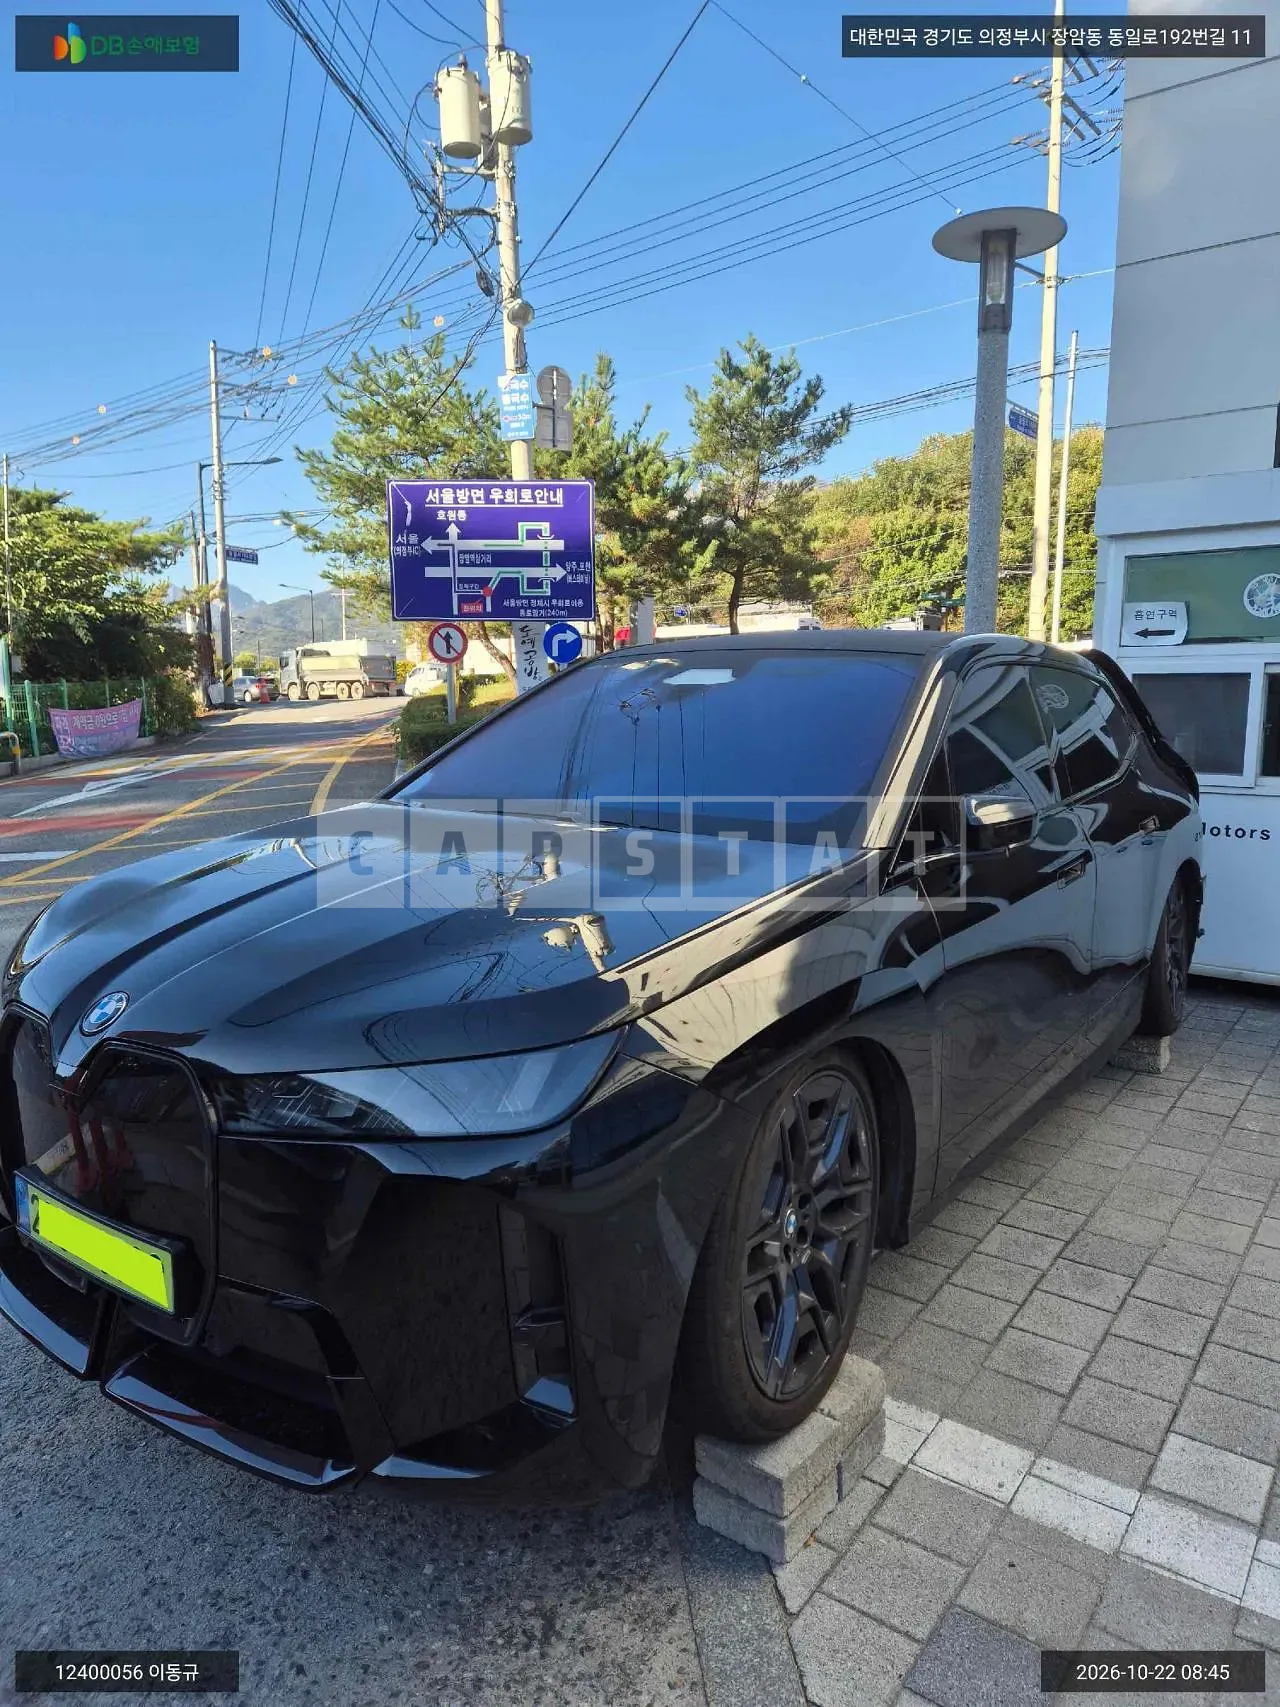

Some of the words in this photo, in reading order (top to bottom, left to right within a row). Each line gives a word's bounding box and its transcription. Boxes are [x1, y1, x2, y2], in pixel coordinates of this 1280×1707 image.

[425, 487, 485, 504] 서울방면
[489, 487, 564, 504] 우회로안내
[436, 509, 467, 521] 호원동
[396, 531, 419, 545] 서울
[1134, 609, 1177, 621] 흡연구역
